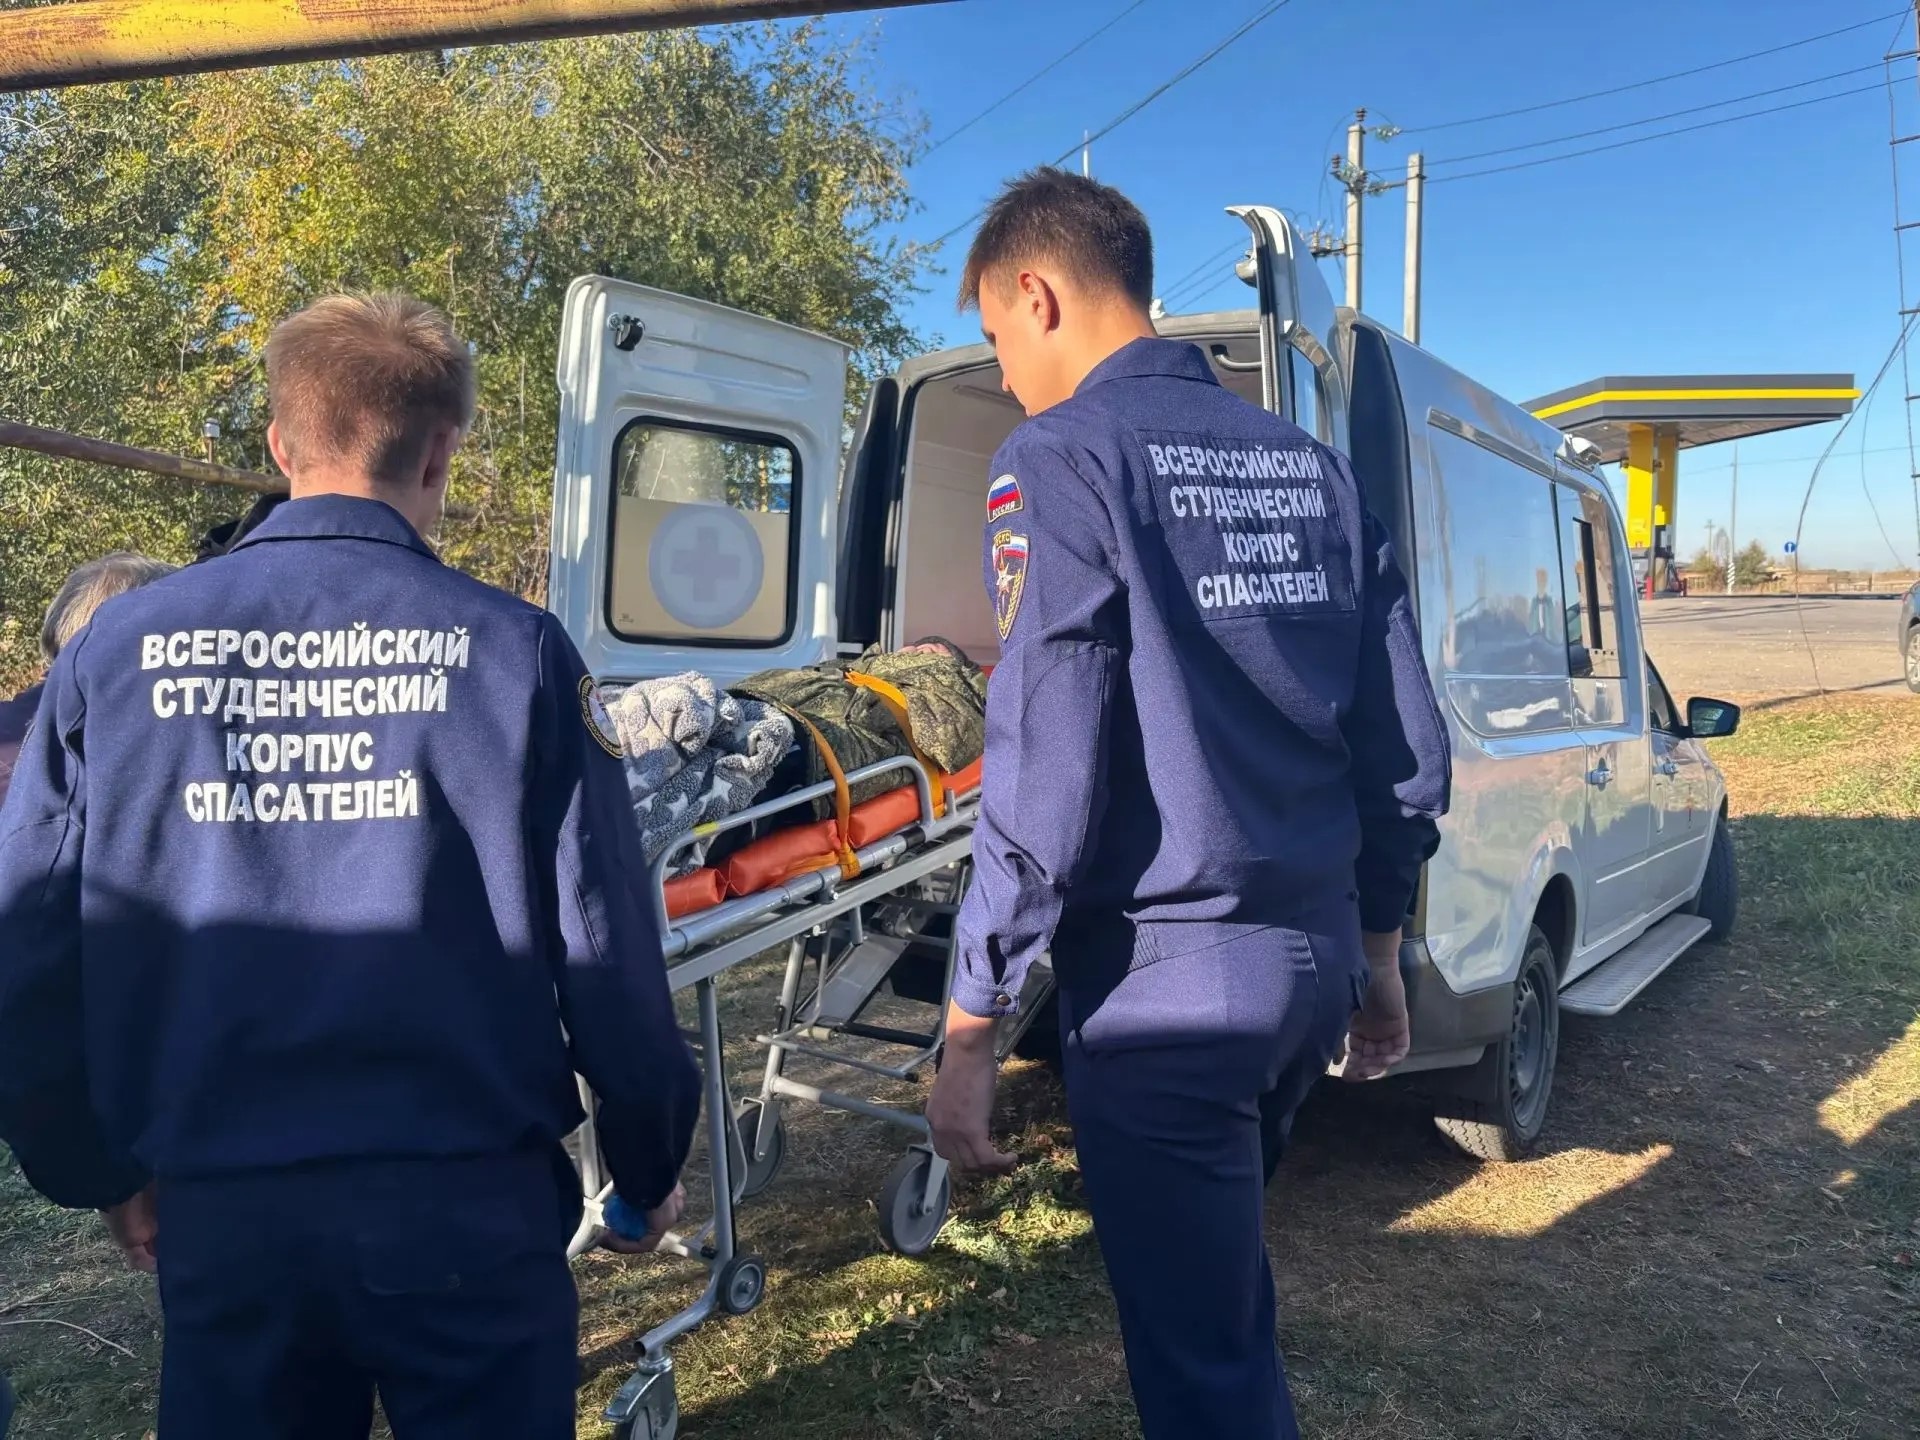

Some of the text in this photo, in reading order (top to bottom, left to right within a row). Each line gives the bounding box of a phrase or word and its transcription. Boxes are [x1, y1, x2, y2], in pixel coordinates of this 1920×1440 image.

[1147, 444, 1323, 480] ВСЕРОССИЙСКИЙ
[1169, 482, 1327, 523] СТУДЕНЧЕСКИЙ
[1223, 532, 1299, 563] КОРПУС
[1197, 564, 1329, 608] СПАСАТЕЛЕЙ
[141, 622, 471, 671] ВСЕРОССИЙСКИЙ
[152, 668, 447, 723] СТУДЕНЧЕСКИЙ
[226, 731, 374, 773] КОРПУС
[185, 770, 419, 823] СПАСАТЕЛЕЙ
